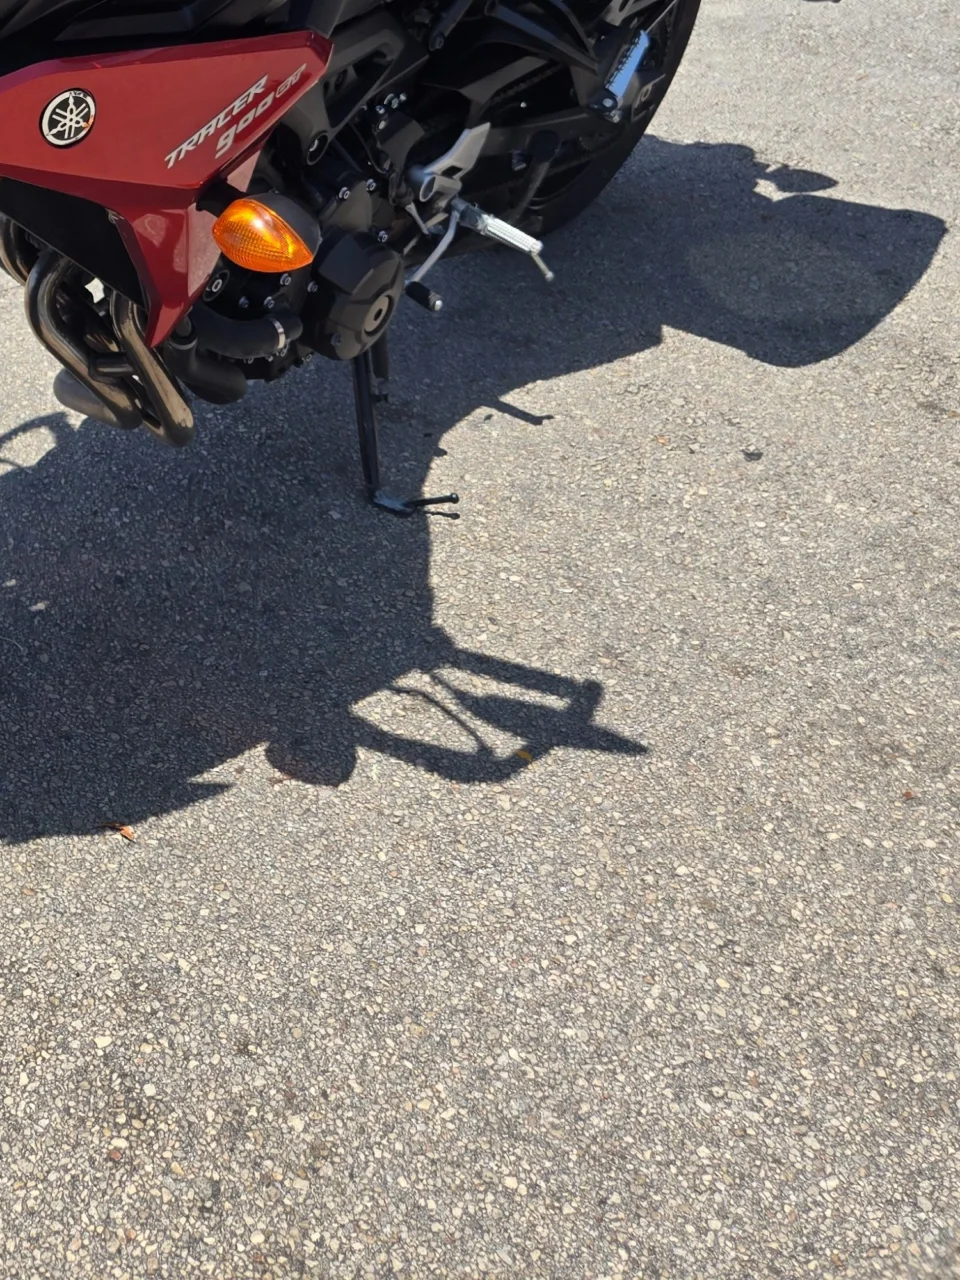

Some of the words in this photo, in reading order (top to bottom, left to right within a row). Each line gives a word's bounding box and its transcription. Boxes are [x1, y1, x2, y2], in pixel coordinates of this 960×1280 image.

[164, 74, 269, 169] TRACER
[215, 91, 275, 159] 900
[275, 63, 307, 98] GT
